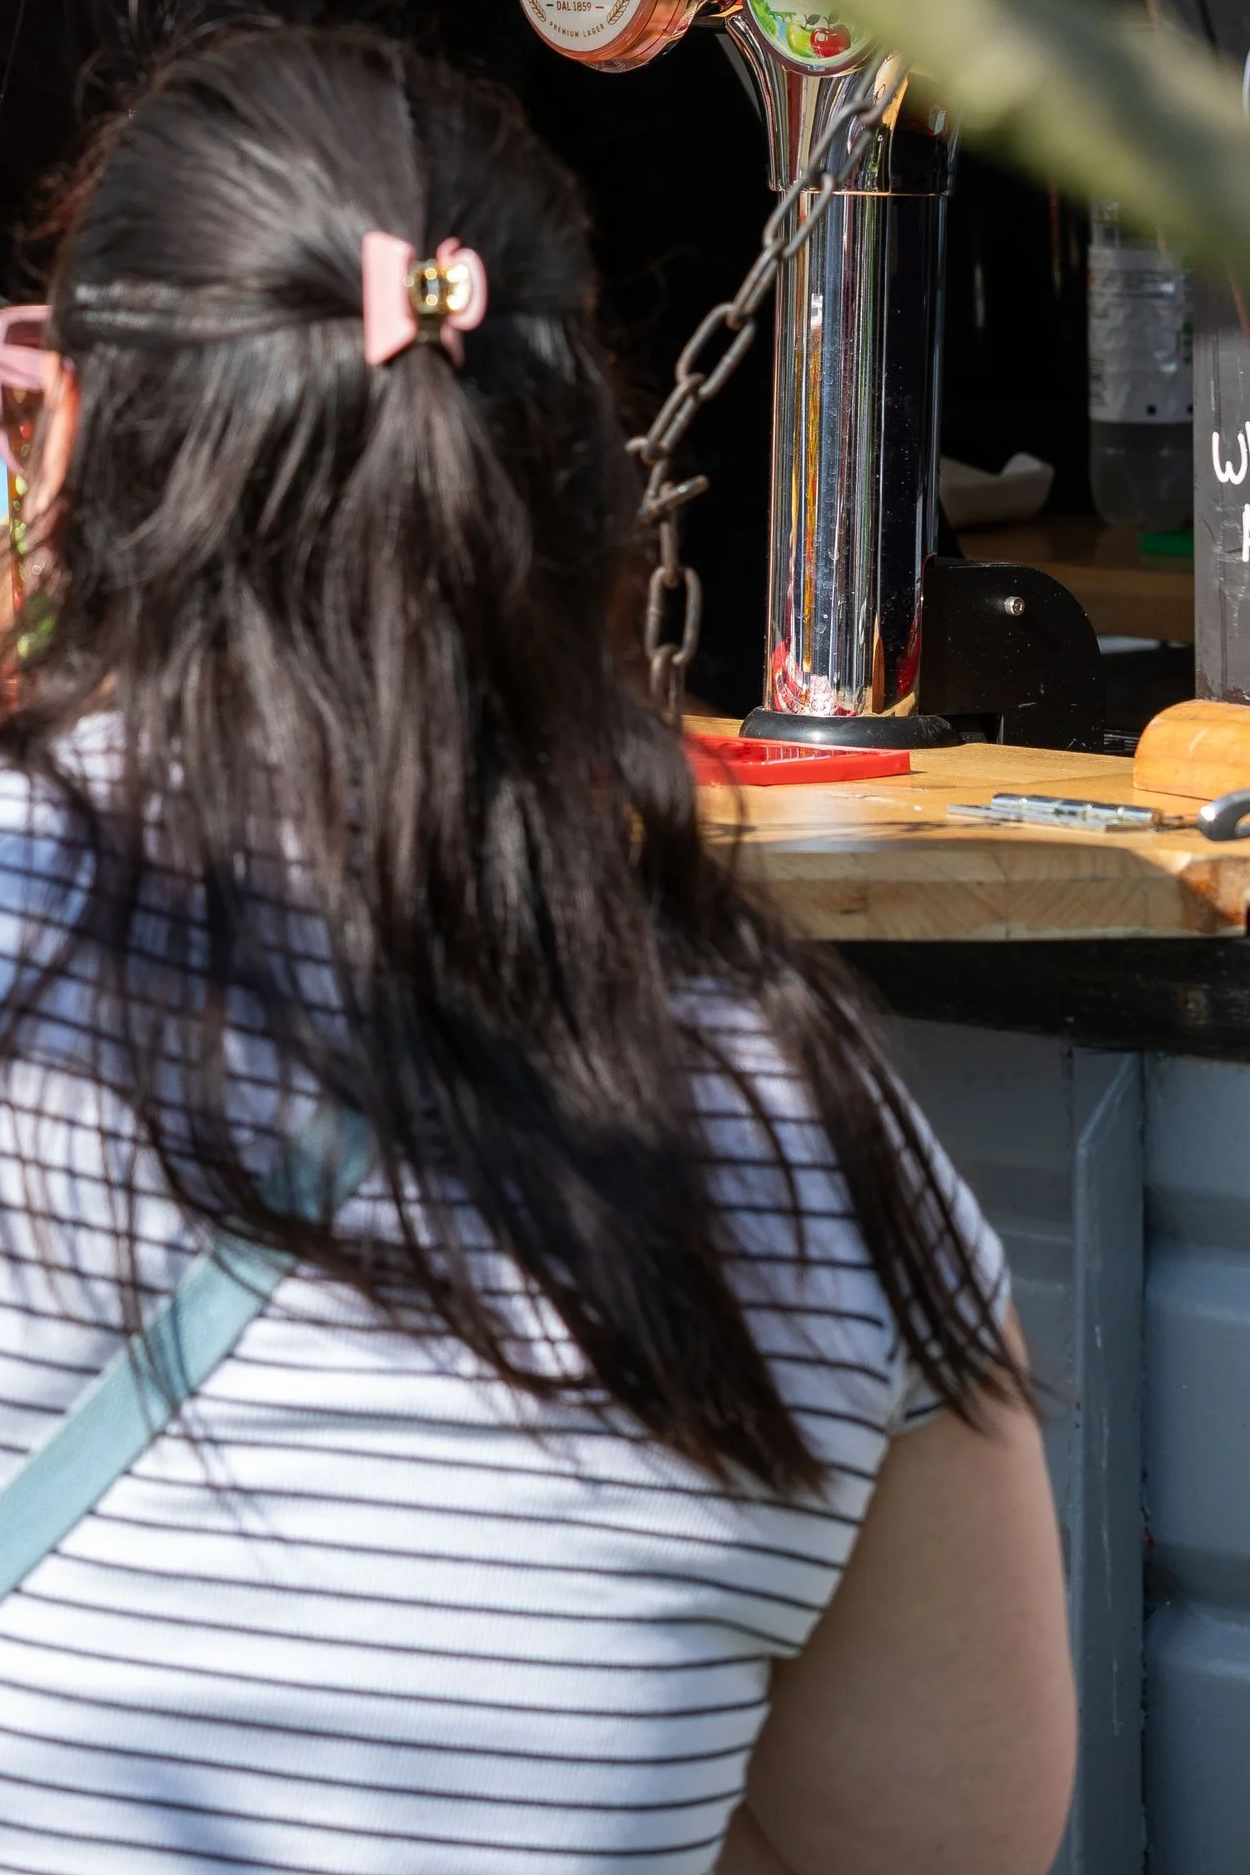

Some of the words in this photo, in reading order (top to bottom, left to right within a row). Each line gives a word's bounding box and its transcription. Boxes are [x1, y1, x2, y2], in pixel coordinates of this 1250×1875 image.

[556, 0, 572, 11] DAL
[572, 1, 592, 12] 1859
[549, 20, 580, 38] PREMIUM
[582, 23, 605, 38] LAGER
